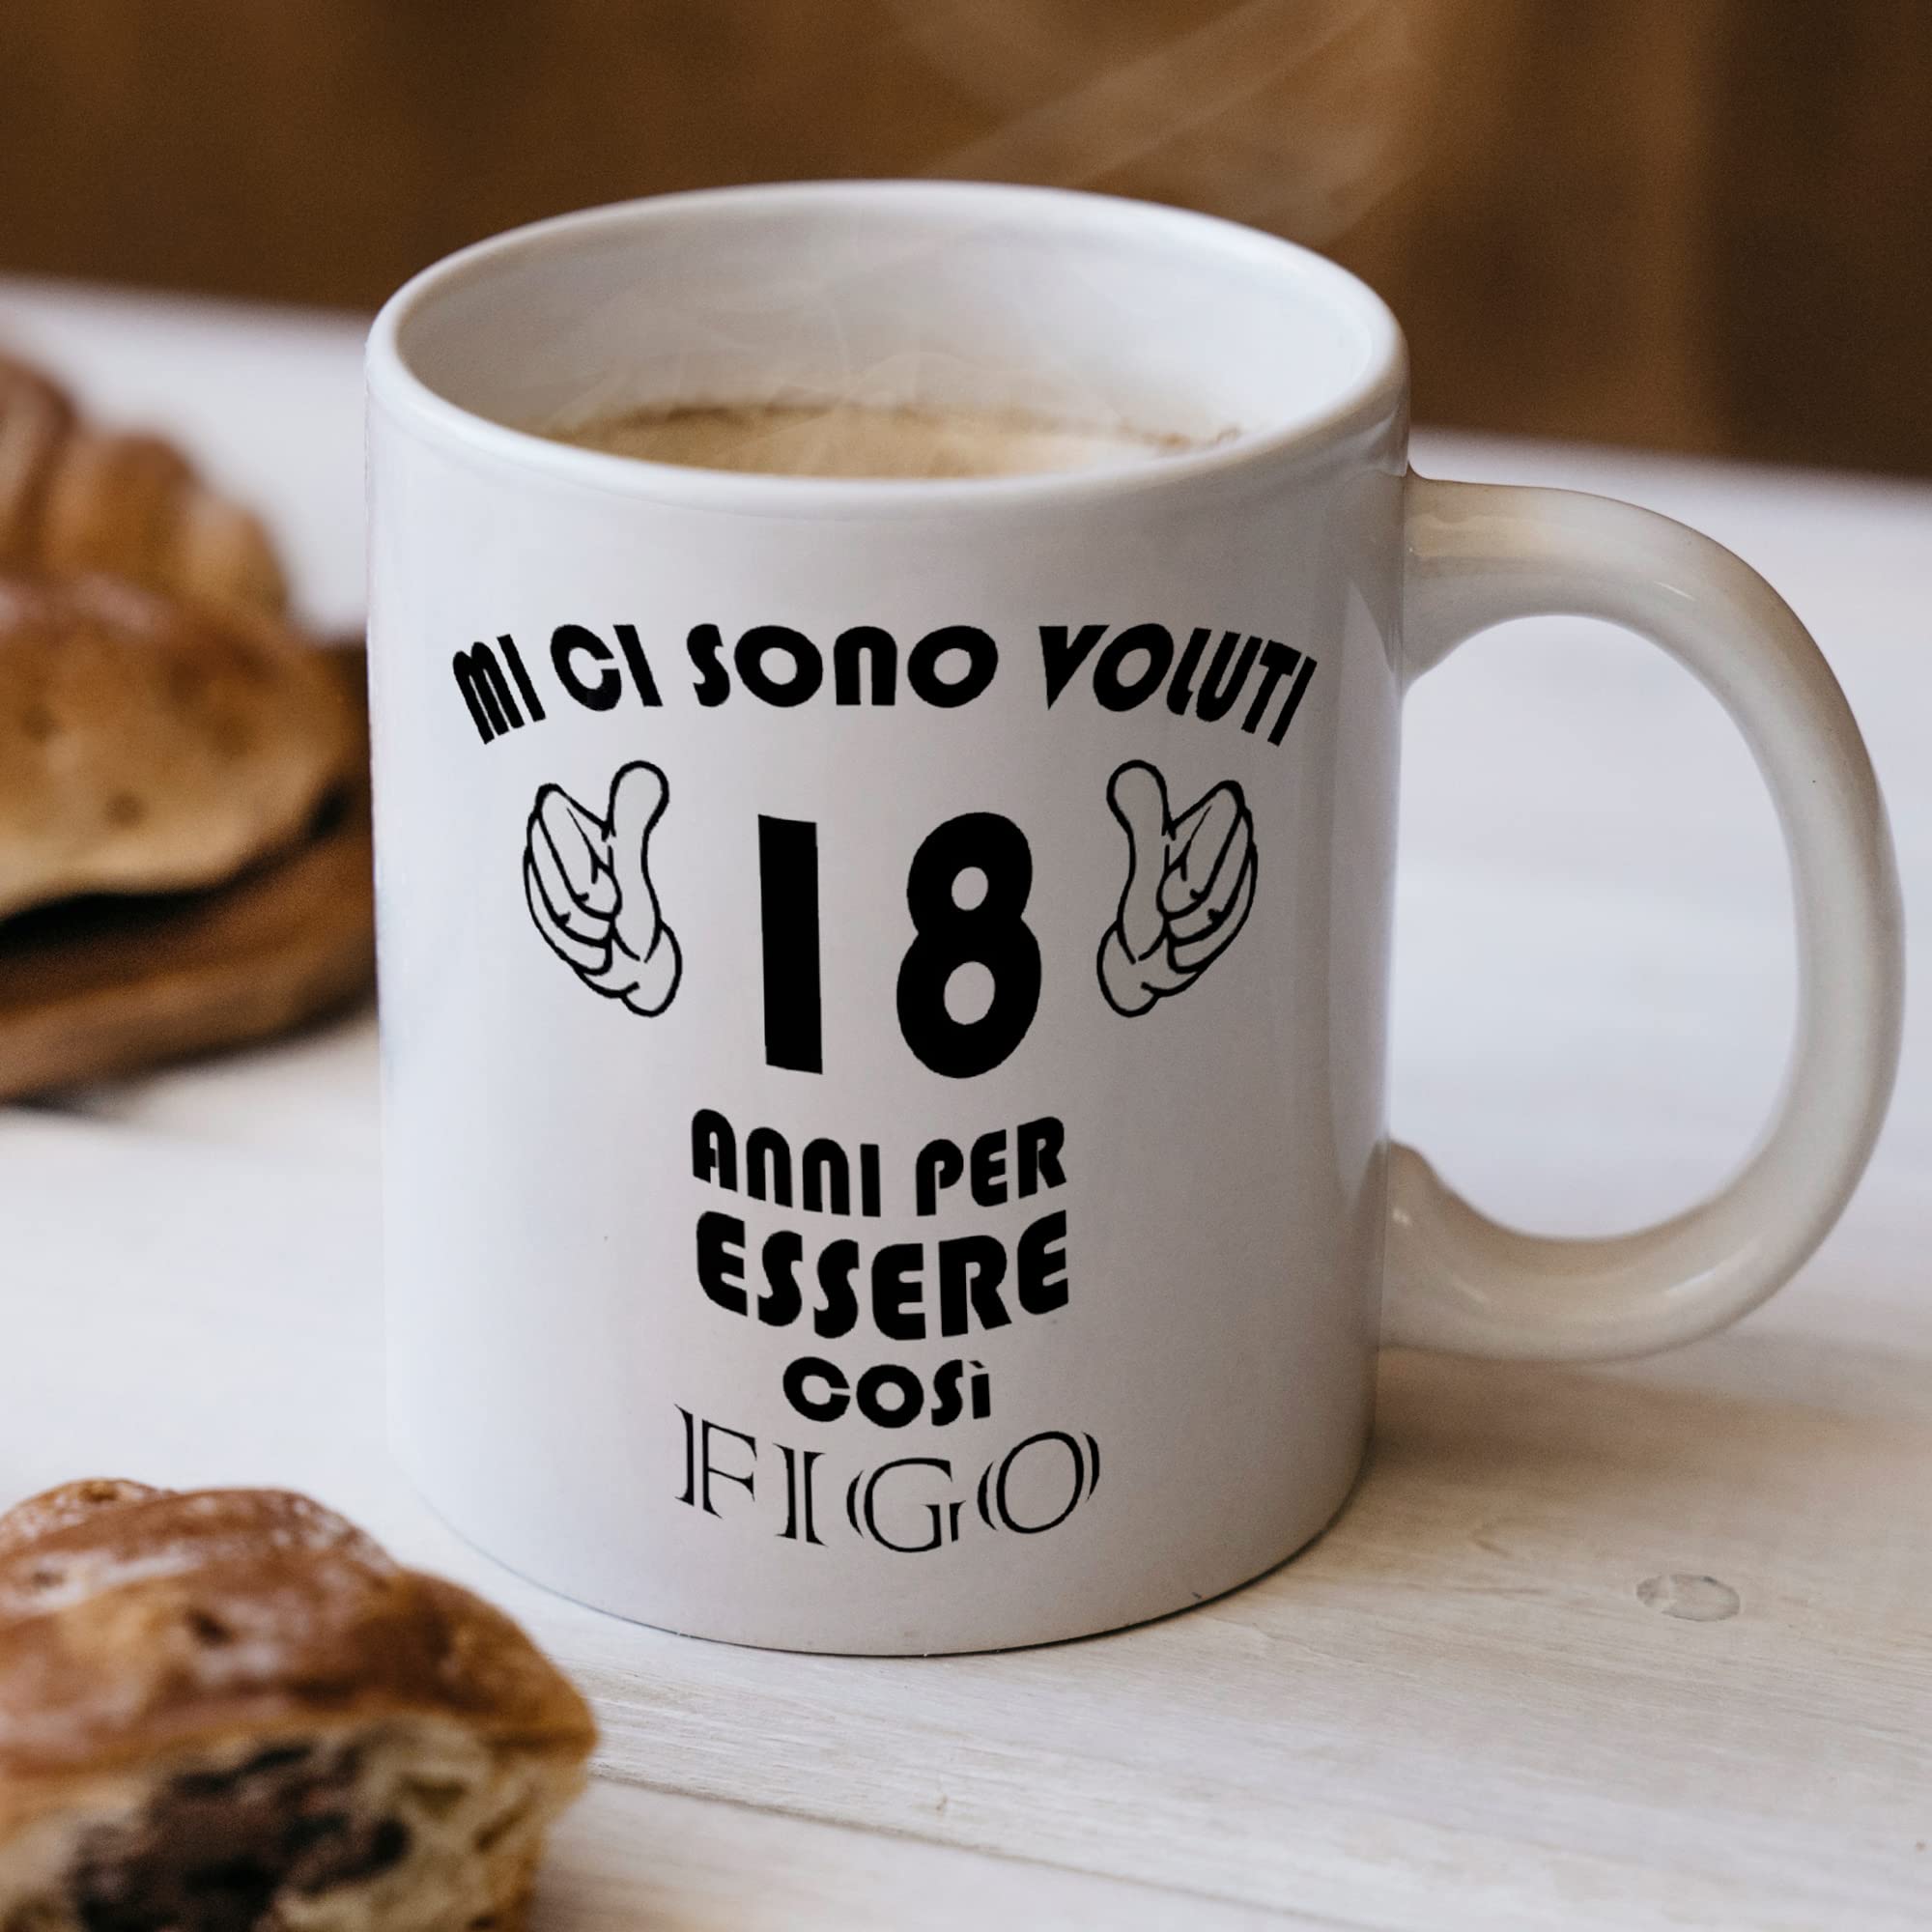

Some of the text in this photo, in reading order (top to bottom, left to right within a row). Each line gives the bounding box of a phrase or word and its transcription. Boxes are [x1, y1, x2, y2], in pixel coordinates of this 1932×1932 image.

[452, 622, 1319, 748] MI CI SONO VOLUTI
[757, 811, 1042, 1079] 18
[691, 1108, 1067, 1218] ANNI PER
[696, 1208, 1069, 1341] ESSERE
[673, 1403, 1100, 1553] FIGO
